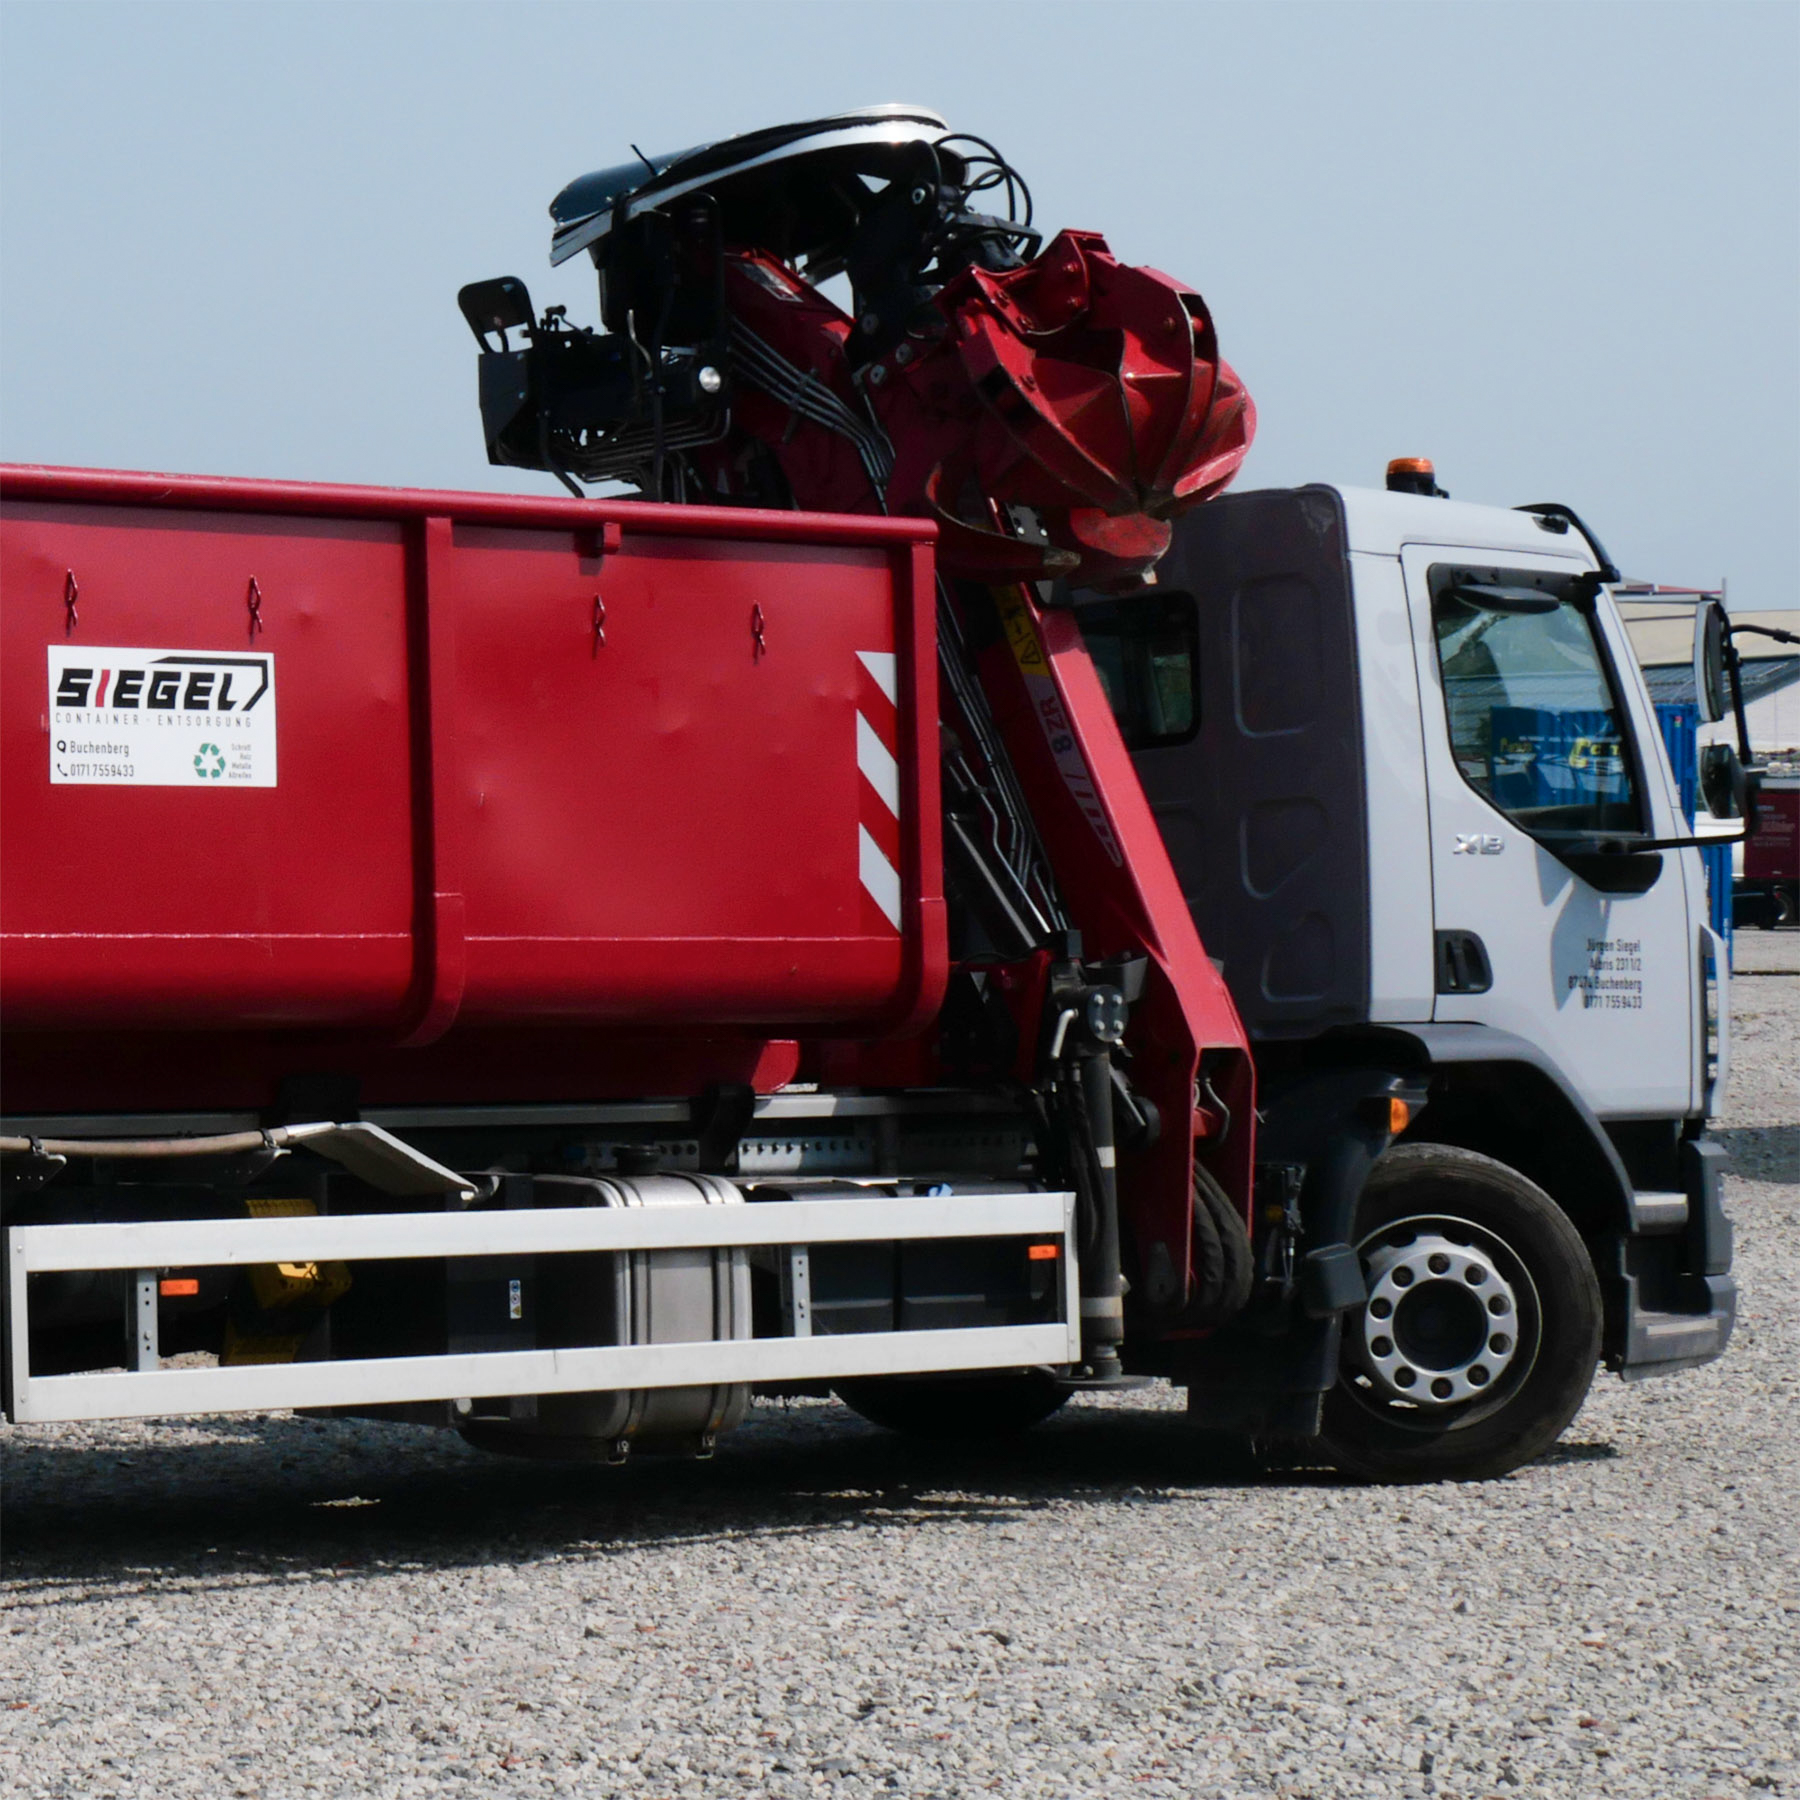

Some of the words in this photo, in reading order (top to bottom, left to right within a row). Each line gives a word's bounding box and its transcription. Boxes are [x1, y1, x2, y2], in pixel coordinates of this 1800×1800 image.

[56, 668, 237, 711] SIEGEL
[55, 712, 140, 725] CONTAINER
[158, 714, 252, 728] ENTSORGUNG
[70, 741, 130, 757] Buchenberg
[1586, 939, 1614, 955] Jürgen
[1617, 939, 1641, 953] Siegel
[1595, 975, 1642, 993] Buchenberg
